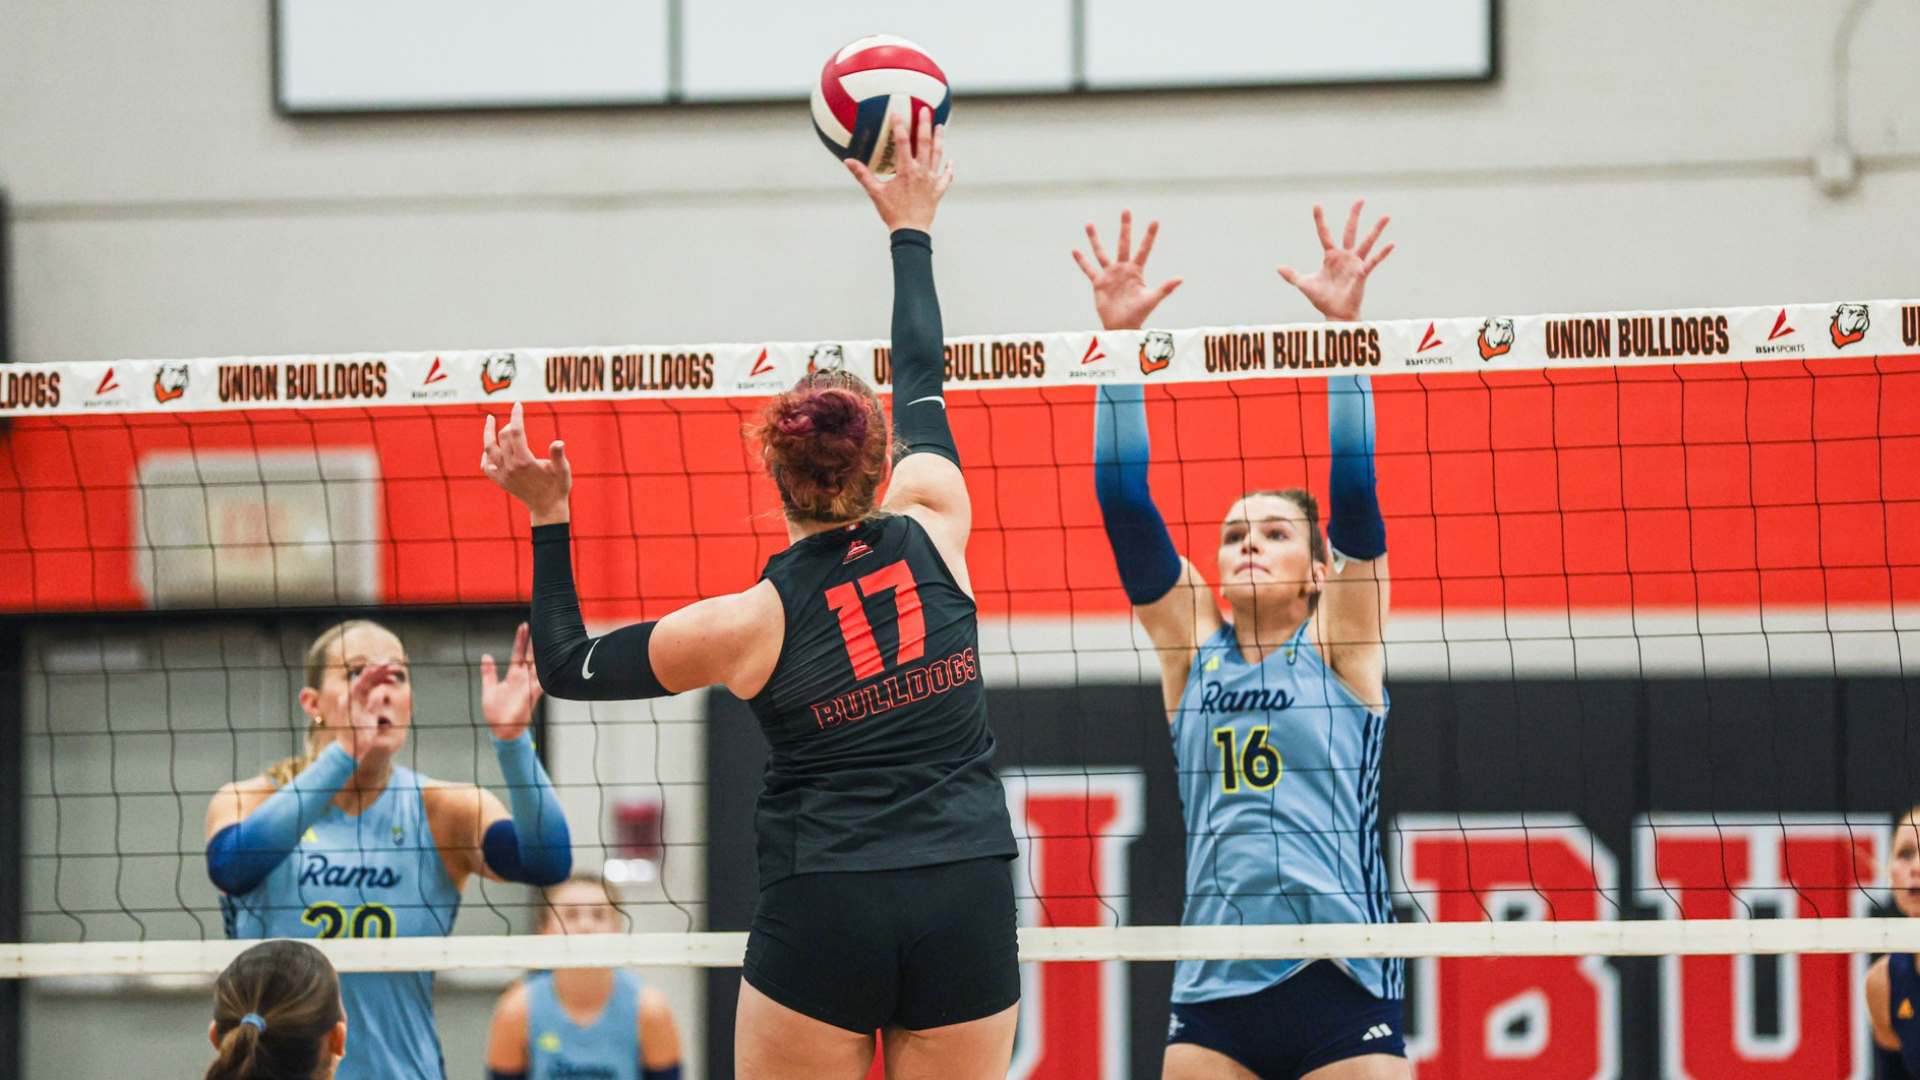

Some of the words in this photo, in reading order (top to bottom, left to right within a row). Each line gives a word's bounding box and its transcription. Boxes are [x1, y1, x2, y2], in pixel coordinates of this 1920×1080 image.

[1204, 331, 1266, 373] UNION
[1272, 327, 1381, 370] BULLDOGS
[1545, 317, 1611, 359] UNION
[1617, 315, 1730, 357] BULLDOGS
[1755, 345, 1775, 354] BSN
[1775, 343, 1805, 353] SPORTS
[218, 364, 278, 402] UNION
[286, 361, 387, 401] BULLDOGS
[545, 355, 605, 394] UNION
[612, 352, 714, 392] BULLDOGS
[943, 340, 1045, 382] BULLDOGS
[1405, 358, 1423, 366] BSN
[1424, 356, 1453, 365] SPORTS
[824, 559, 927, 681] 17
[810, 647, 978, 730] BULLDOGS
[1200, 680, 1295, 715] Rams
[1213, 726, 1283, 793] 16
[301, 854, 402, 888] Rams
